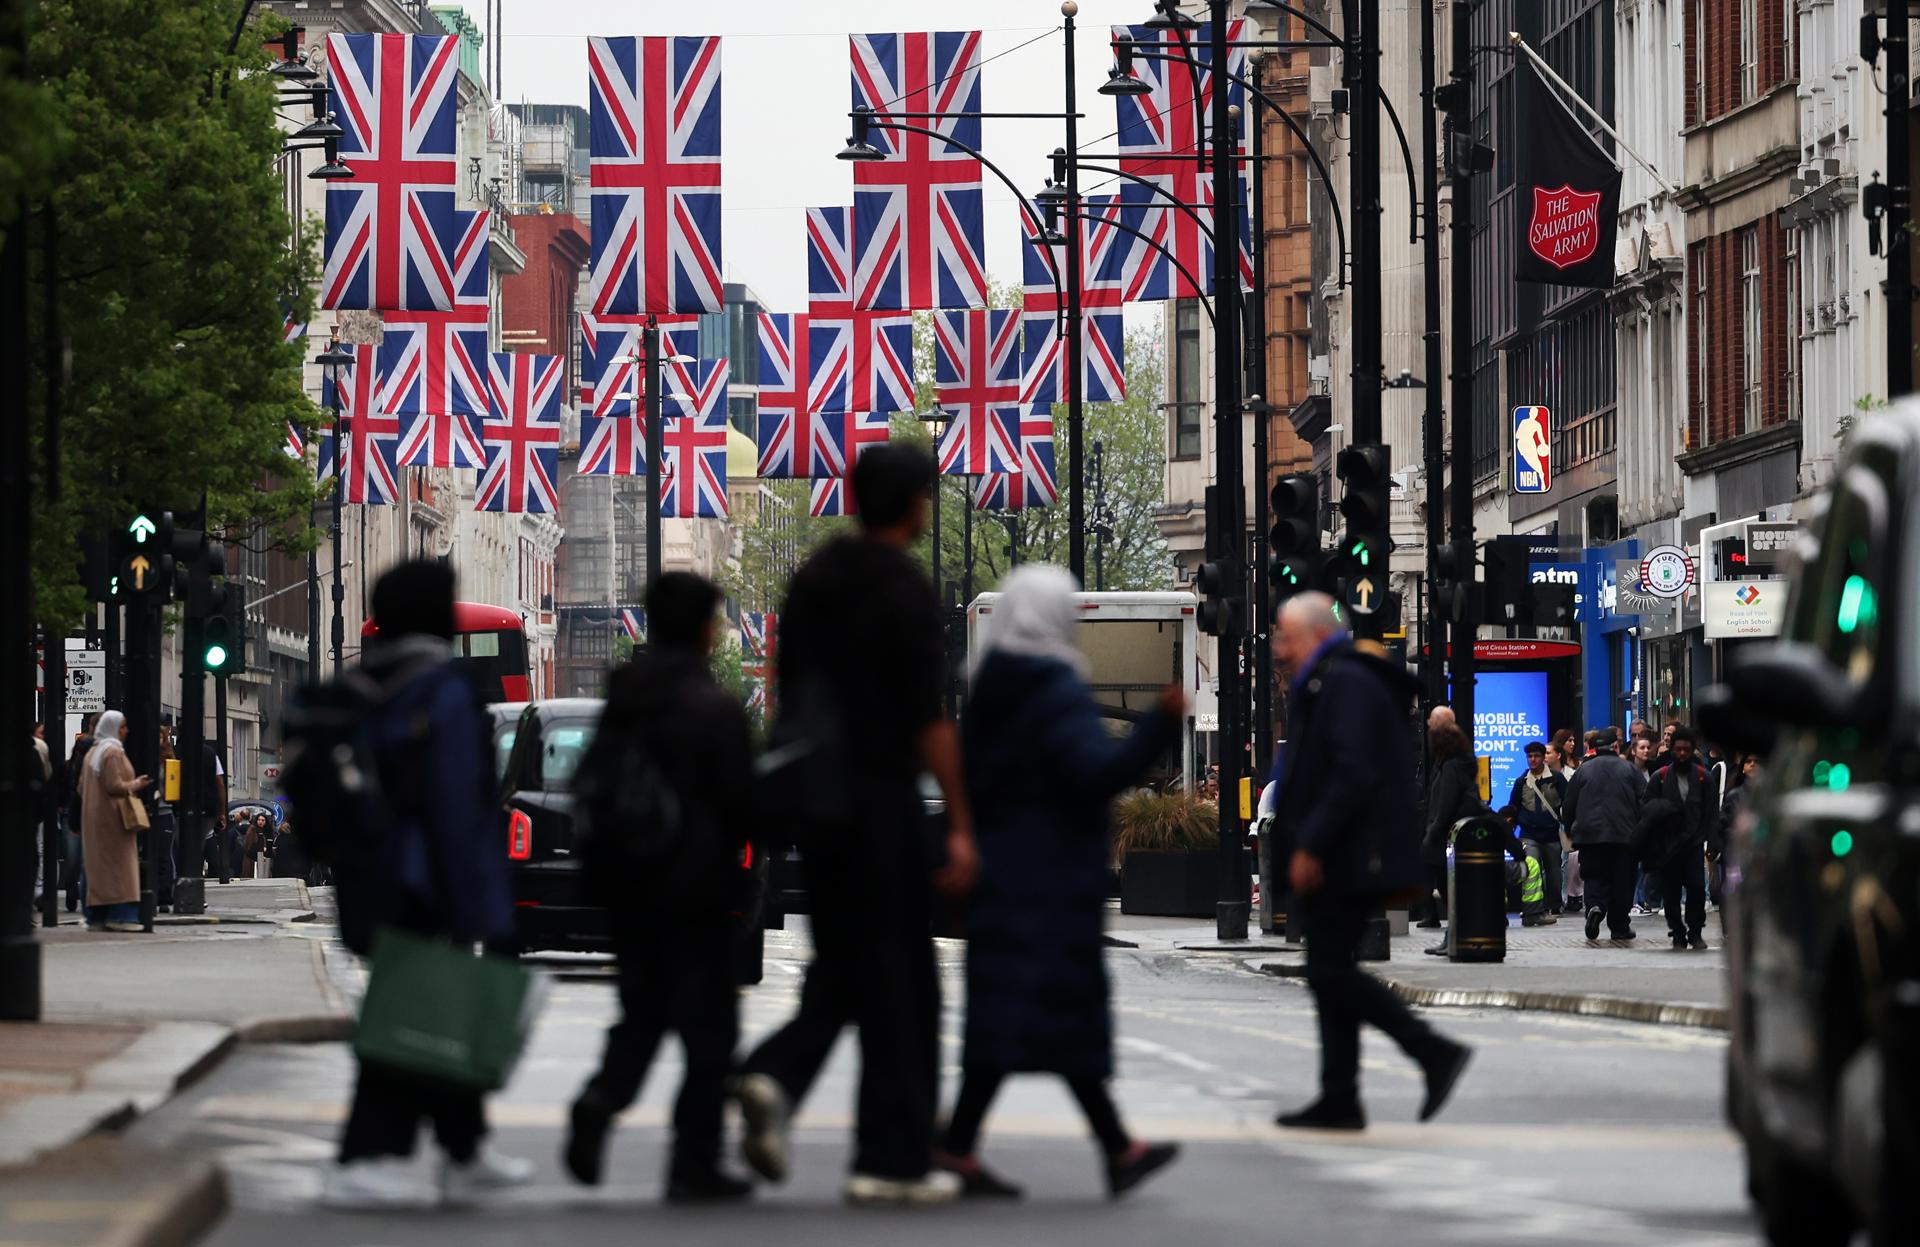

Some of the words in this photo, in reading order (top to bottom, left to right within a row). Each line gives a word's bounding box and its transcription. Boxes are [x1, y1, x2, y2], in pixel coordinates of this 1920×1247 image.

[1547, 196, 1569, 217] THE
[1533, 203, 1594, 243] SALVATION
[1553, 227, 1590, 257] ARMY
[1520, 471, 1538, 487] NBA
[1656, 555, 1678, 564] FUEL
[1532, 567, 1579, 585] atm
[1674, 579, 1681, 587] go
[1726, 618, 1749, 626] English
[1474, 712, 1526, 725] MOBILE
[1489, 724, 1544, 737] PRICES.
